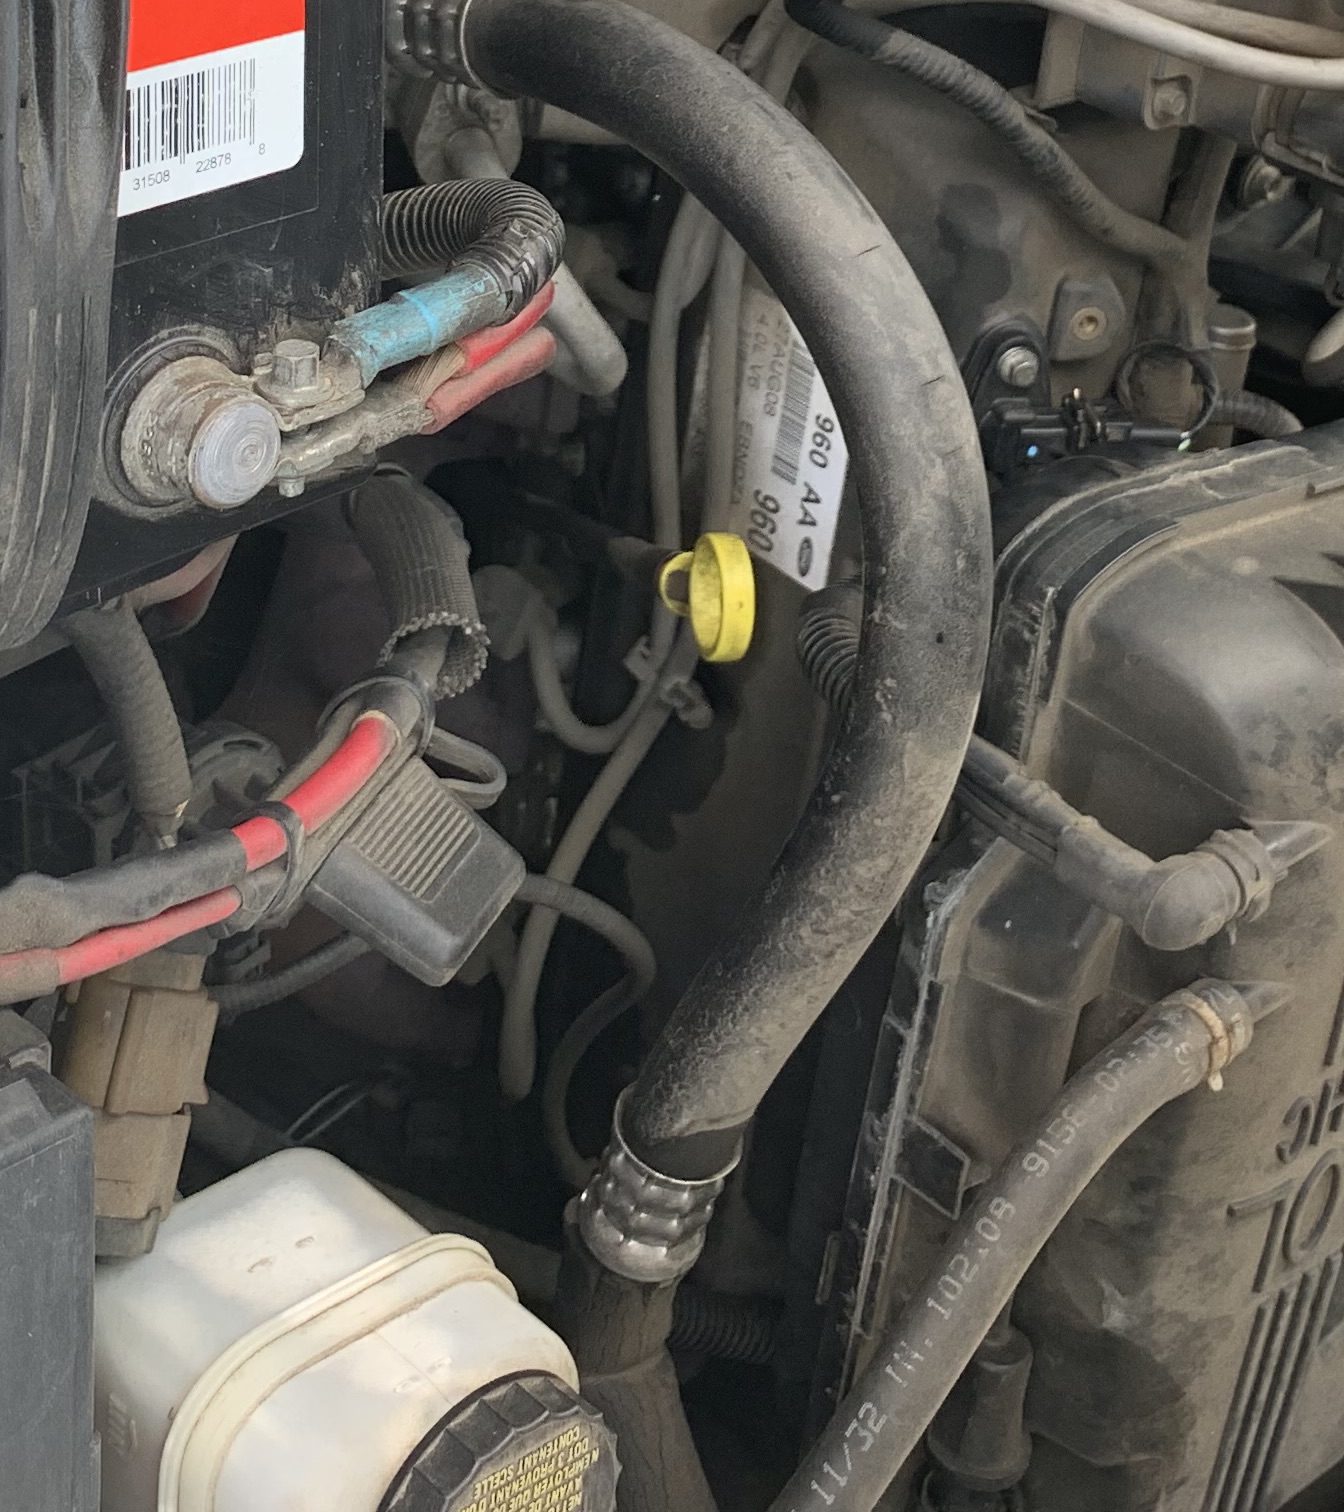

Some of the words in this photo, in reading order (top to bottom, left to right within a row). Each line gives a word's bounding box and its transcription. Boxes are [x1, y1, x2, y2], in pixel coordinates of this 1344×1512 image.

[132, 170, 171, 191] 31508
[195, 152, 232, 174] 22878
[258, 143, 266, 156] 8
[808, 413, 835, 469] 960
[747, 489, 782, 554] 960
[797, 481, 822, 528] AA
[516, 1426, 580, 1476] CONTENANT
[567, 1437, 589, 1463] DOT
[810, 1402, 888, 1506] 11/32
[473, 1464, 515, 1500] SCELLE
[488, 1457, 556, 1509] PROVENANT
